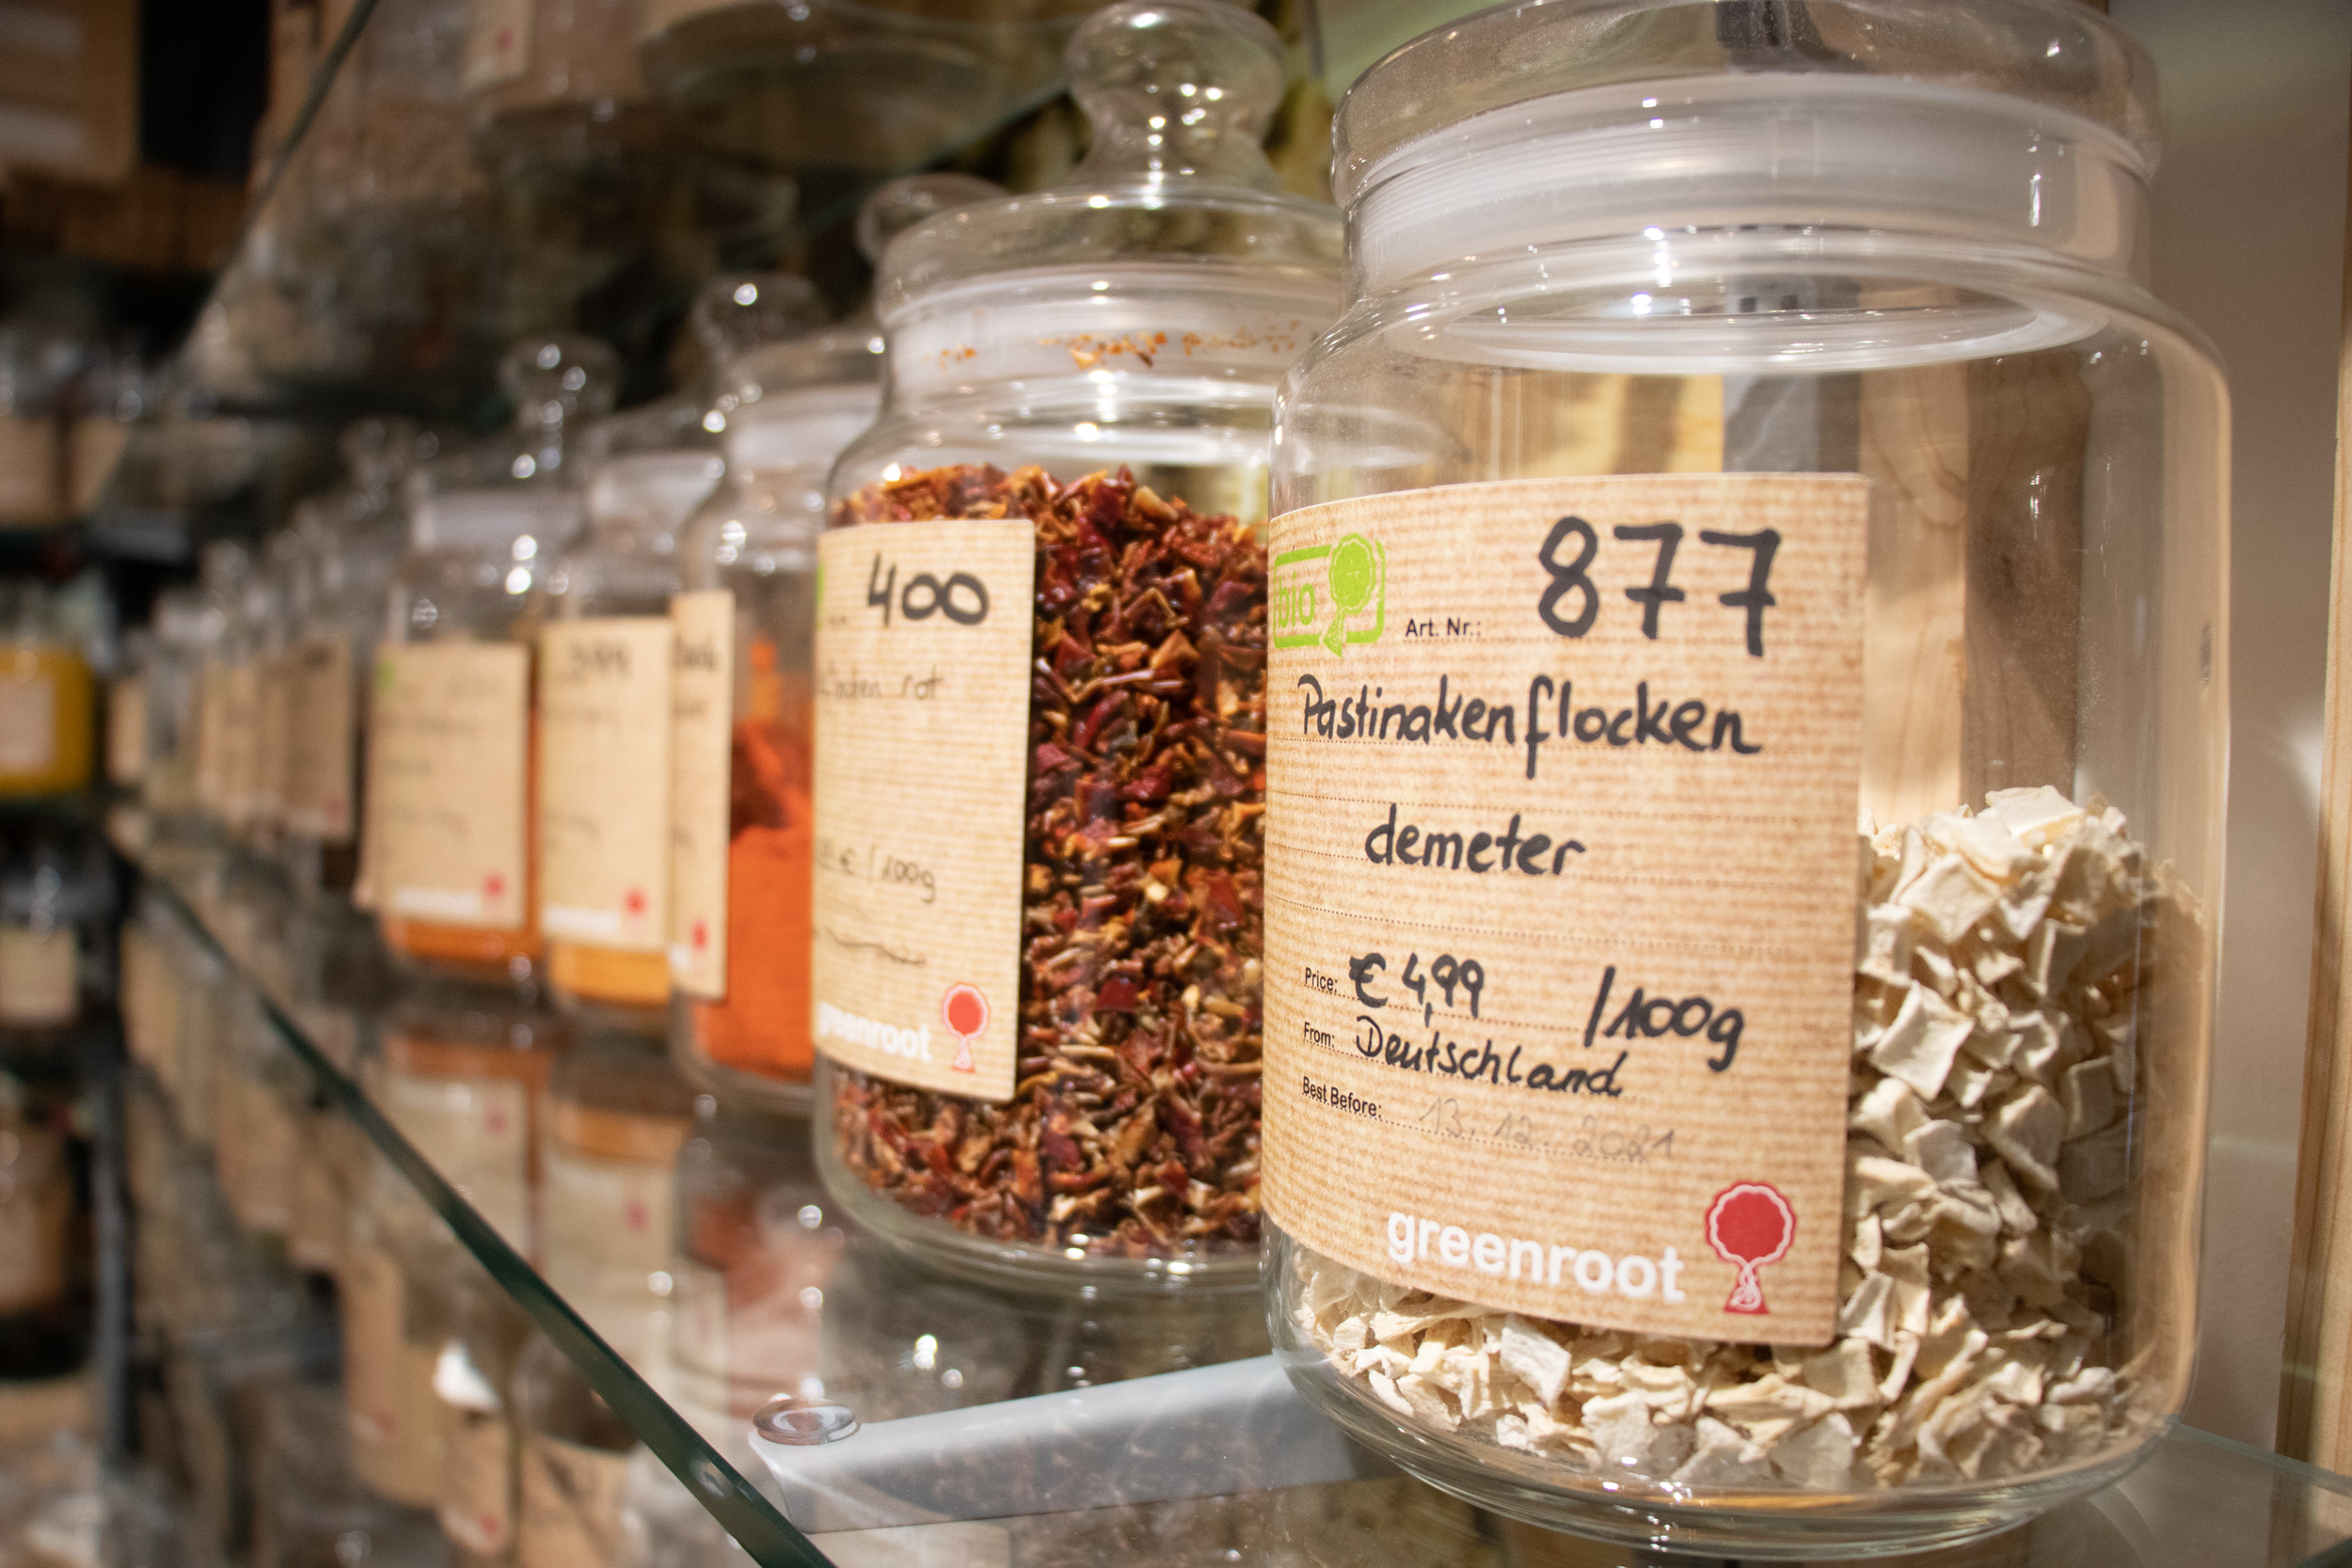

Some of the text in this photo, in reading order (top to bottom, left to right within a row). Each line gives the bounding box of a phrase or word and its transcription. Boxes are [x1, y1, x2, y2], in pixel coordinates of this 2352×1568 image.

[866, 551, 990, 628] 400
[1279, 570, 1316, 629] bio
[1538, 515, 1782, 657] 877
[1405, 617, 1483, 638] Art. Nr.:
[1297, 673, 1764, 780] Pastinakenflocken
[1364, 802, 1587, 876] demeter
[1304, 966, 1339, 993] Price:
[1303, 1015, 1629, 1098] From: Deutschland
[1302, 1075, 1329, 1106] Best
[1329, 1085, 1384, 1120] Before:
[1386, 1211, 1687, 1304] greenroot
